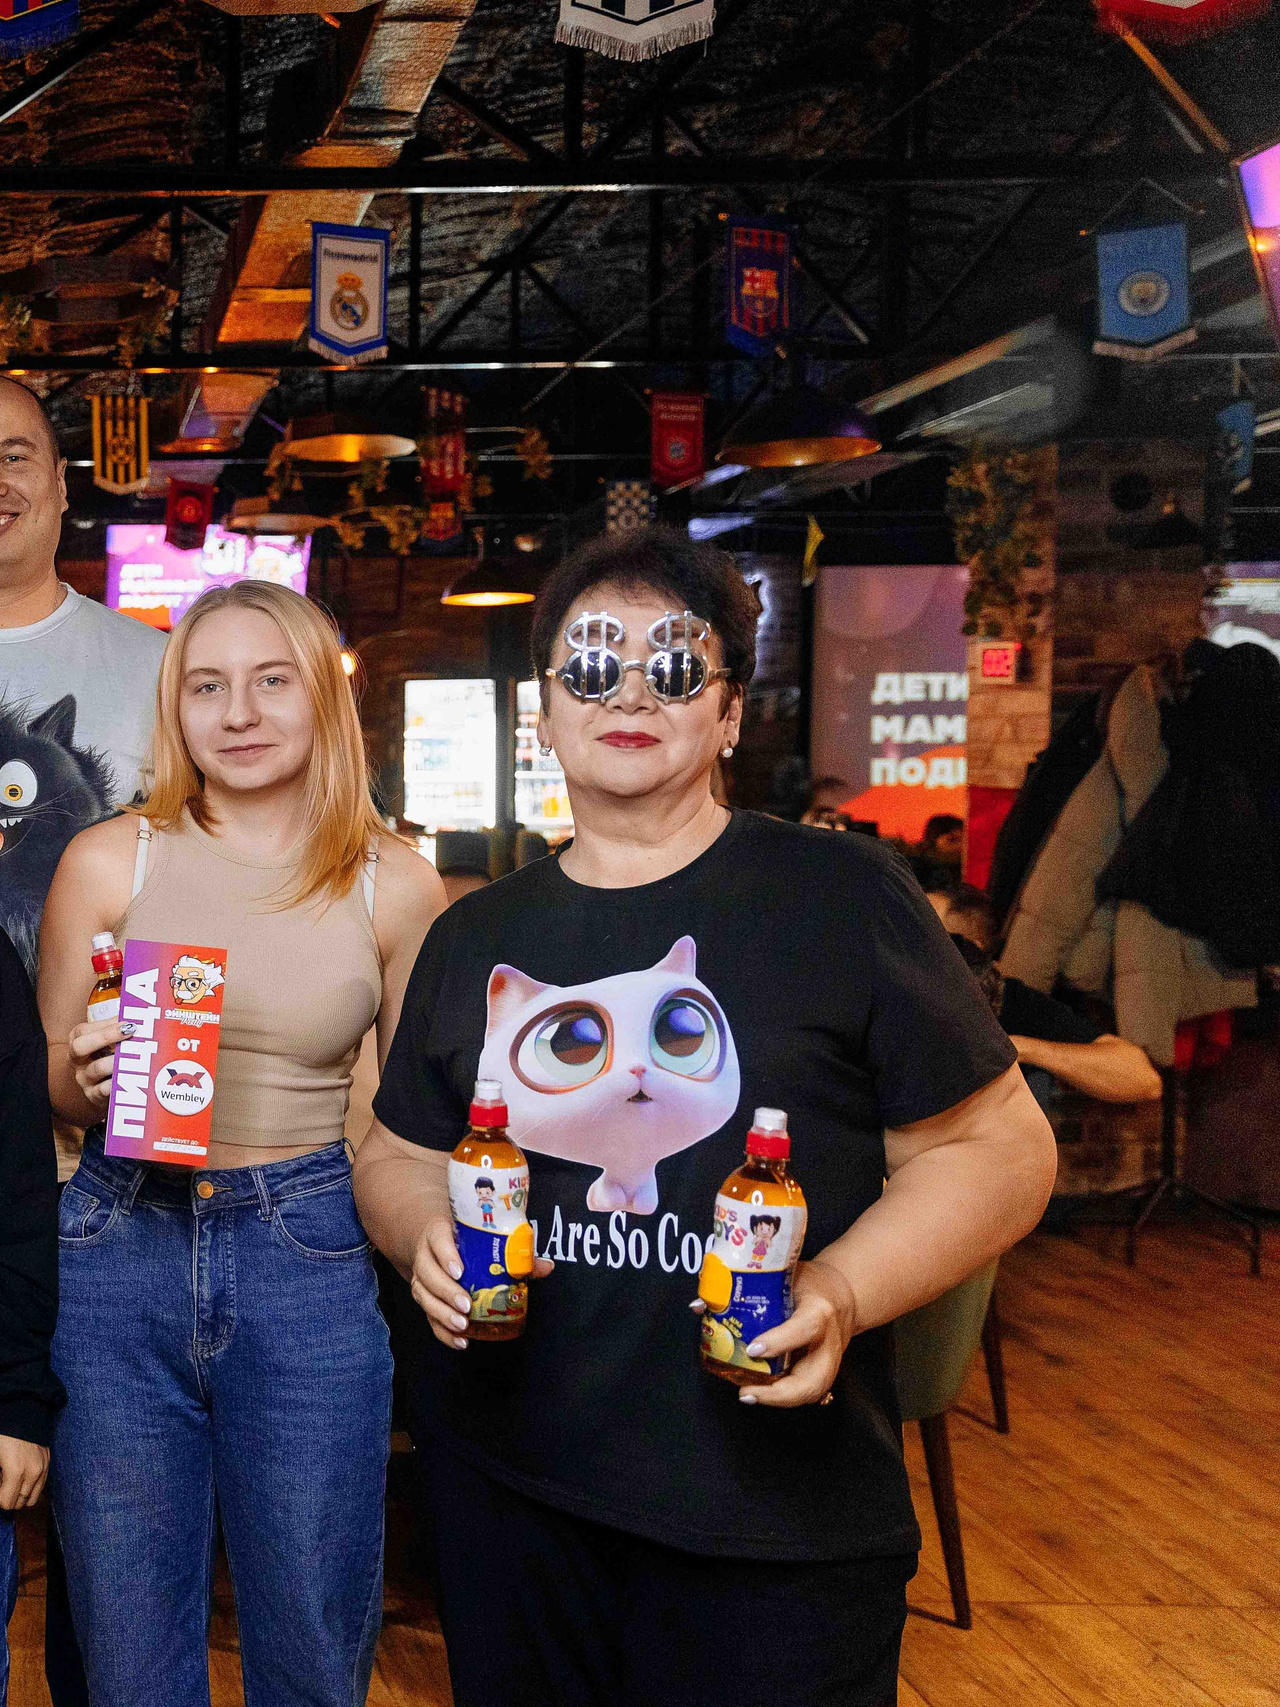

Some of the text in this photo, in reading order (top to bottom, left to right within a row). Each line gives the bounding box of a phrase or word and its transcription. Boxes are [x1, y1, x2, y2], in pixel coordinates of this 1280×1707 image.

[871, 672, 967, 705] ДЕТИ
[112, 968, 161, 1139] ПИЦЦА
[177, 1037, 200, 1052] ОТ
[161, 1090, 205, 1105] Wembley
[542, 1205, 601, 1266] Are
[607, 1210, 649, 1269] So
